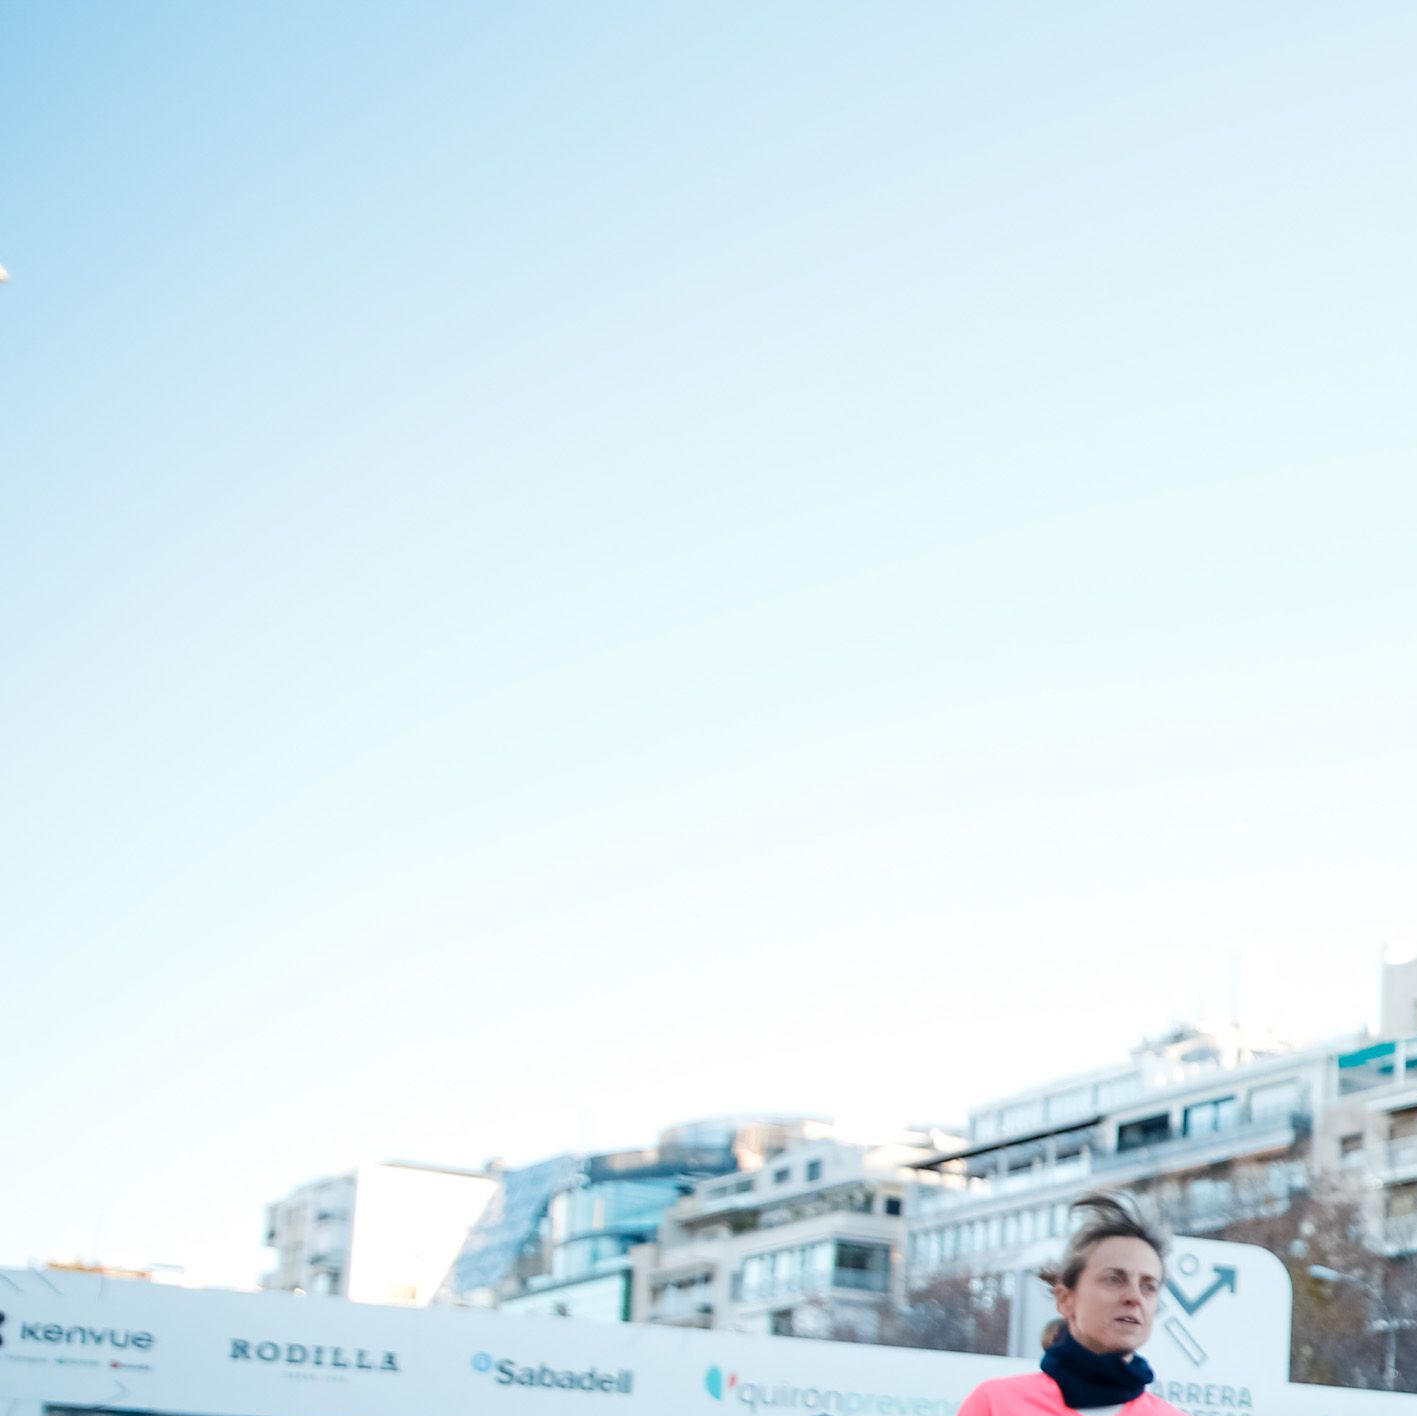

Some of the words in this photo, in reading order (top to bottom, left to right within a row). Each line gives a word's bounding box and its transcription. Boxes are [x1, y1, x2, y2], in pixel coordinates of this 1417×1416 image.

[229, 1337, 400, 1371] RODILLA
[494, 1358, 634, 1393] Sabadell
[1150, 1381, 1253, 1409] ARRERA
